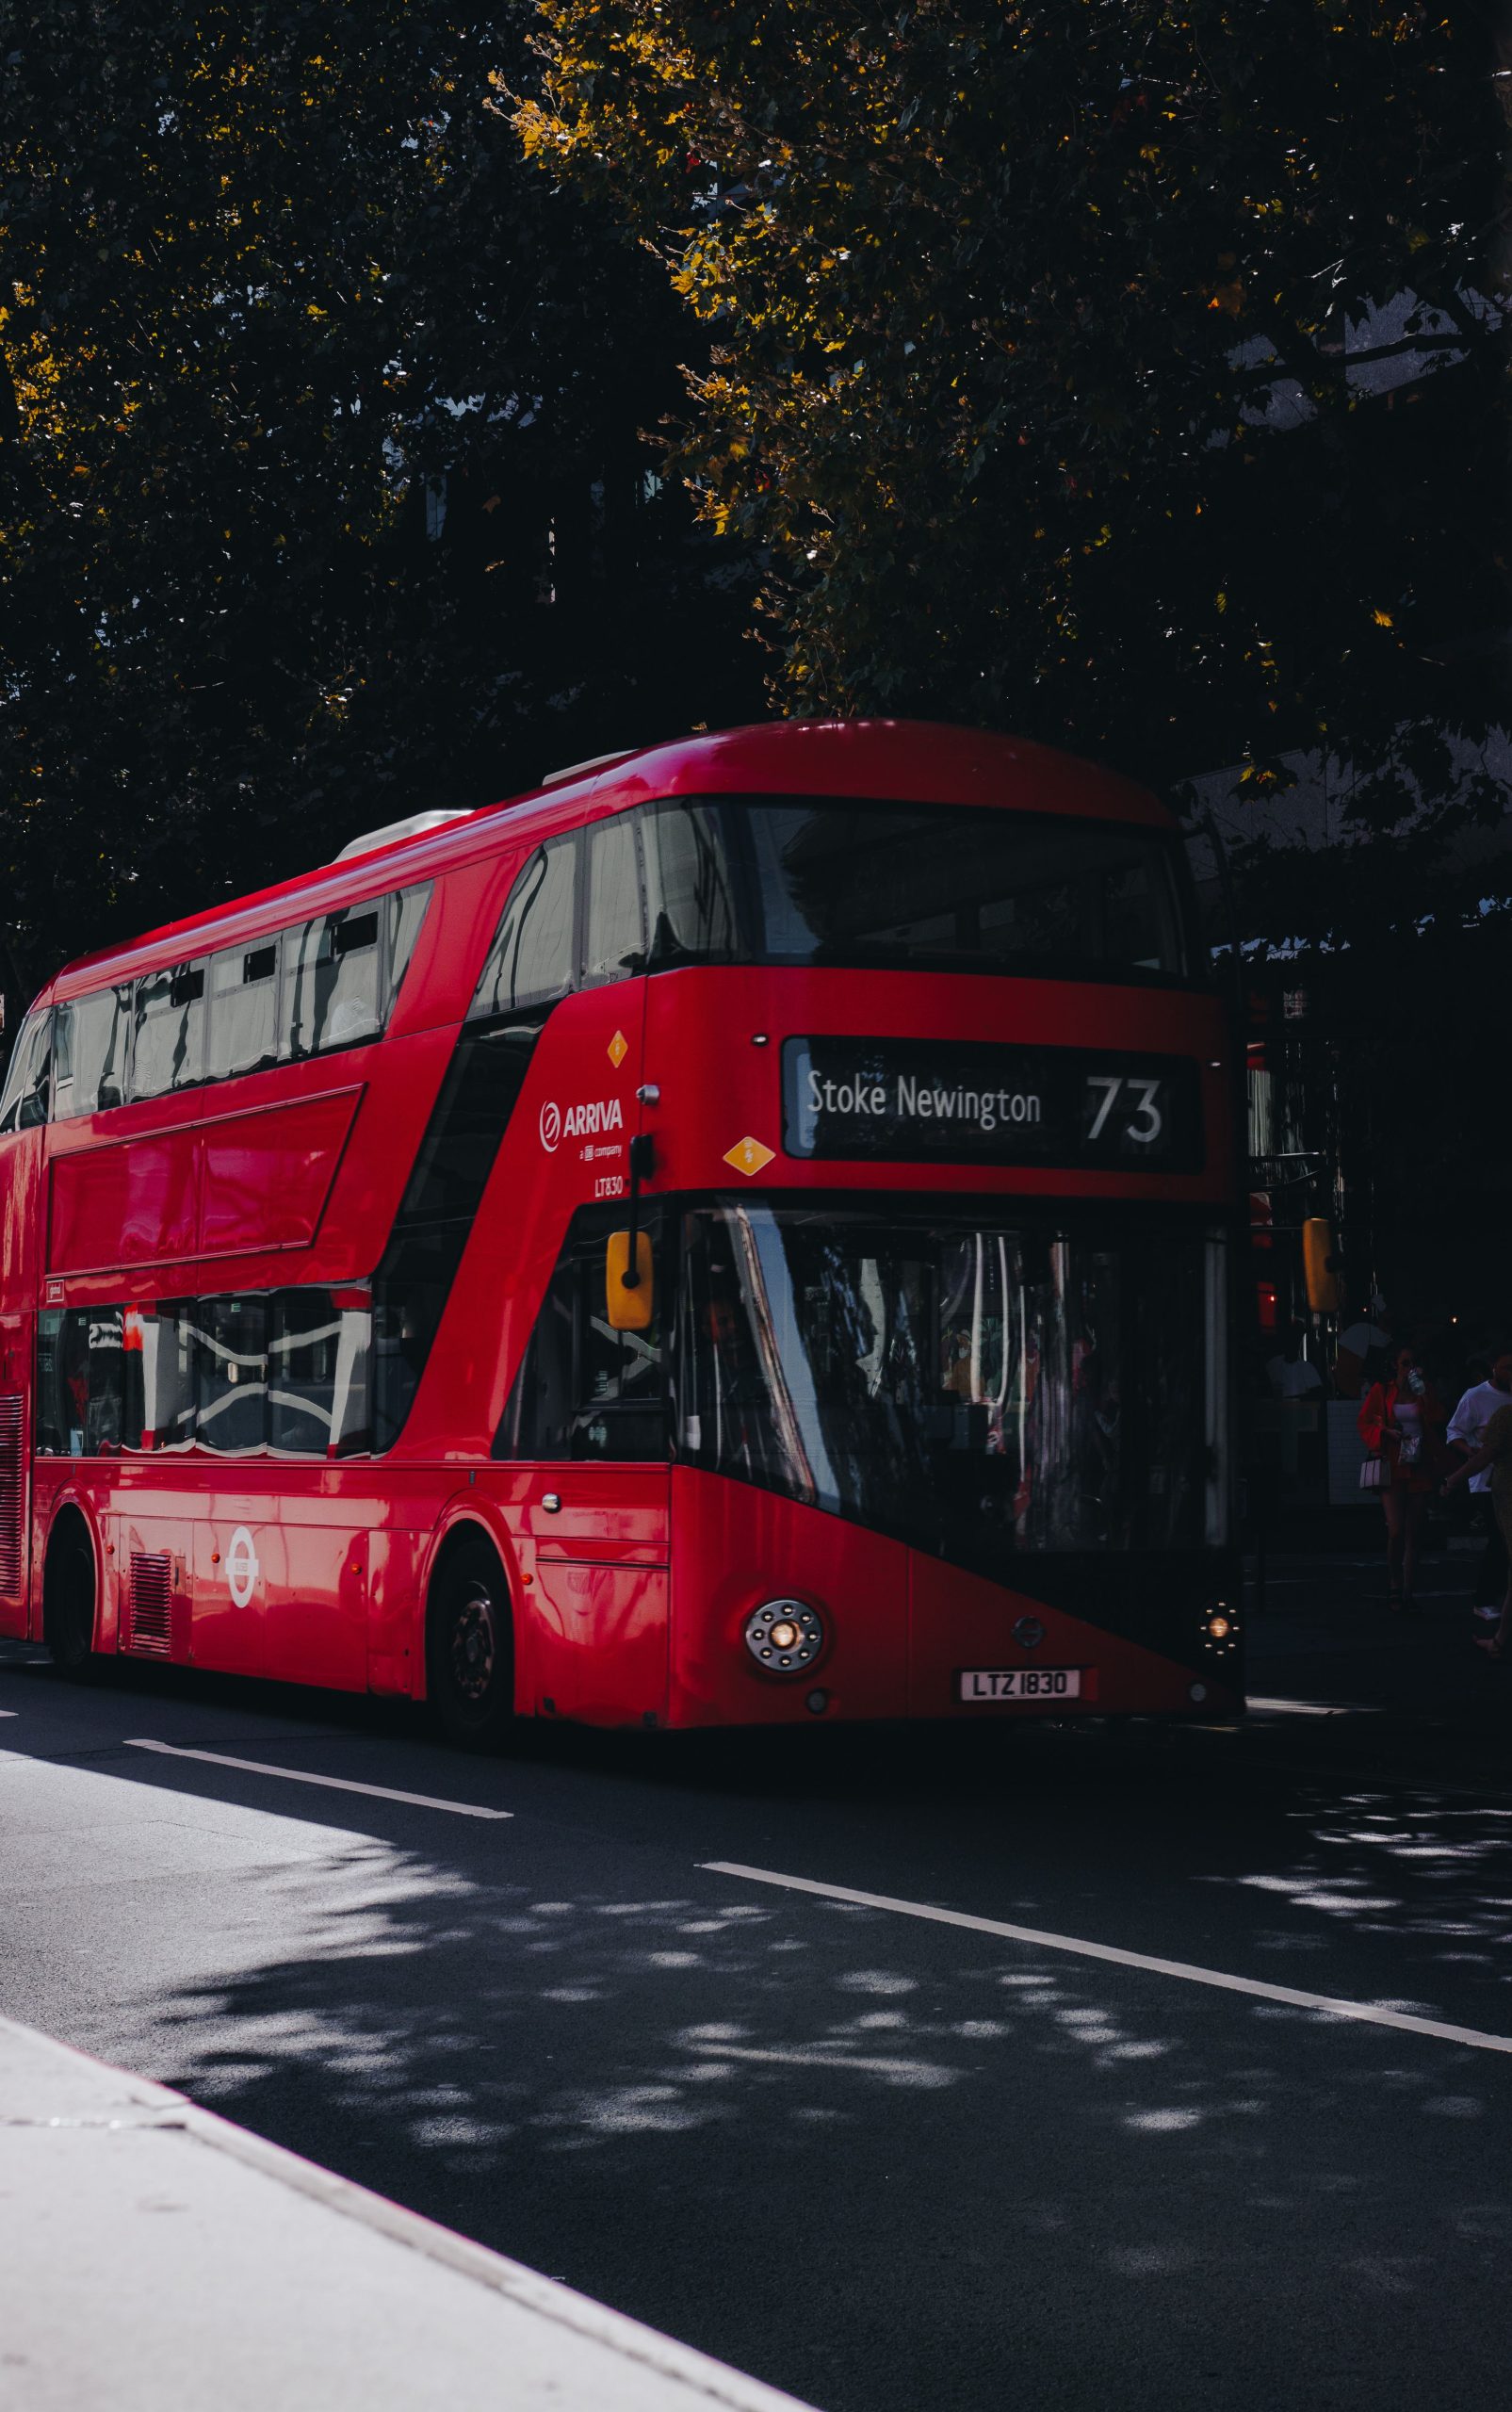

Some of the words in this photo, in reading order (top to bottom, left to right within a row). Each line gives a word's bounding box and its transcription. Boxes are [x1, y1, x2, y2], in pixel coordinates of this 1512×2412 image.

[563, 1099, 624, 1137] ARRIVA
[808, 1070, 886, 1116] Stoke
[898, 1075, 1041, 1131] Newington
[1086, 1077, 1162, 1143] 73
[594, 1175, 623, 1198] LT830
[974, 1674, 1015, 1696] LTZ
[1020, 1672, 1067, 1695] 1830
